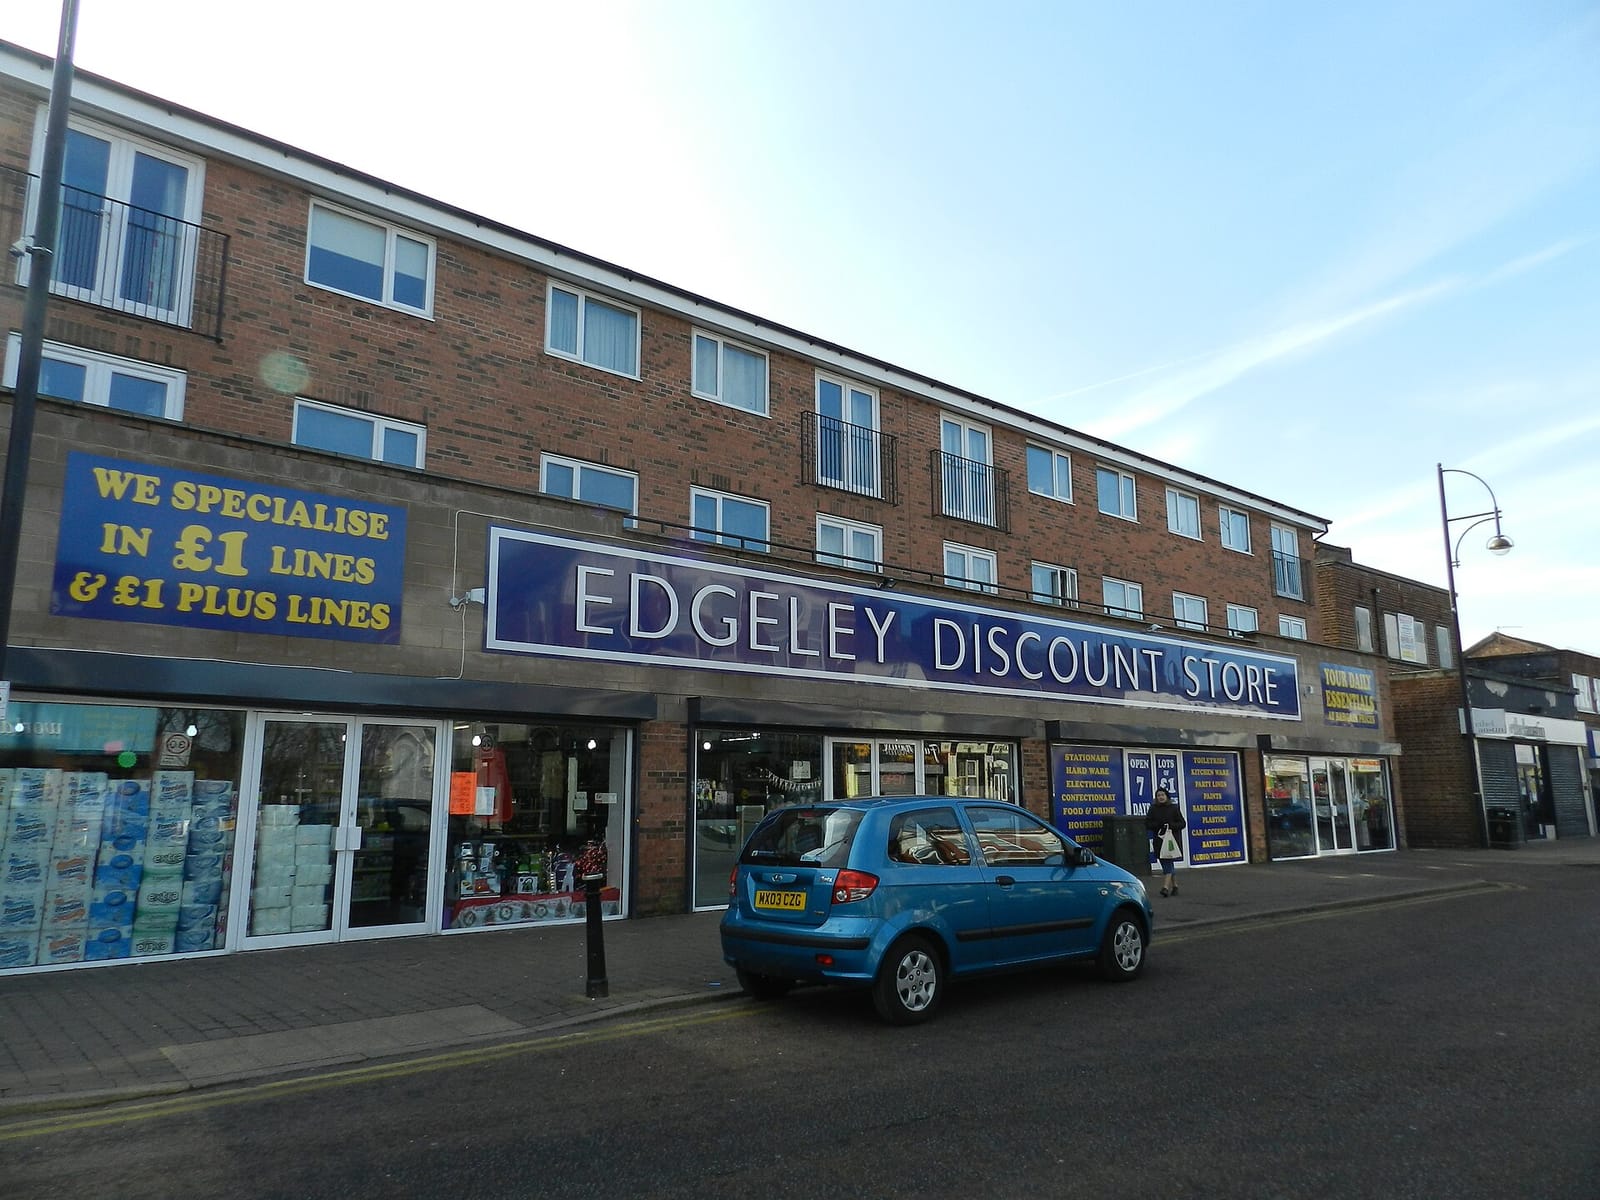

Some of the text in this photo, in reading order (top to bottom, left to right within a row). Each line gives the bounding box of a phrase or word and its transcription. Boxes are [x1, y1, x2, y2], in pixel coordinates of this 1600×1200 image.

[93, 467, 390, 541] WE SPECIALISE
[101, 523, 376, 585] IN £1 LINES
[70, 571, 391, 631] & £1 PLUS LINES
[575, 564, 1280, 706] EDGELEY DISCOUNT STORE
[1323, 668, 1371, 690] YOUR DAILY
[1325, 689, 1375, 713] ESSENTIALS
[1130, 758, 1149, 769] OPEN
[1158, 759, 1175, 769] LOTS
[1136, 775, 1145, 796] 7
[1160, 777, 1176, 793] £1
[1093, 807, 1116, 815] DRINK
[1068, 821, 1103, 829] HOUSEHO
[1202, 816, 1226, 824] PLASTICS
[1192, 829, 1203, 837] CAR
[758, 892, 802, 907] MX03 CZG
